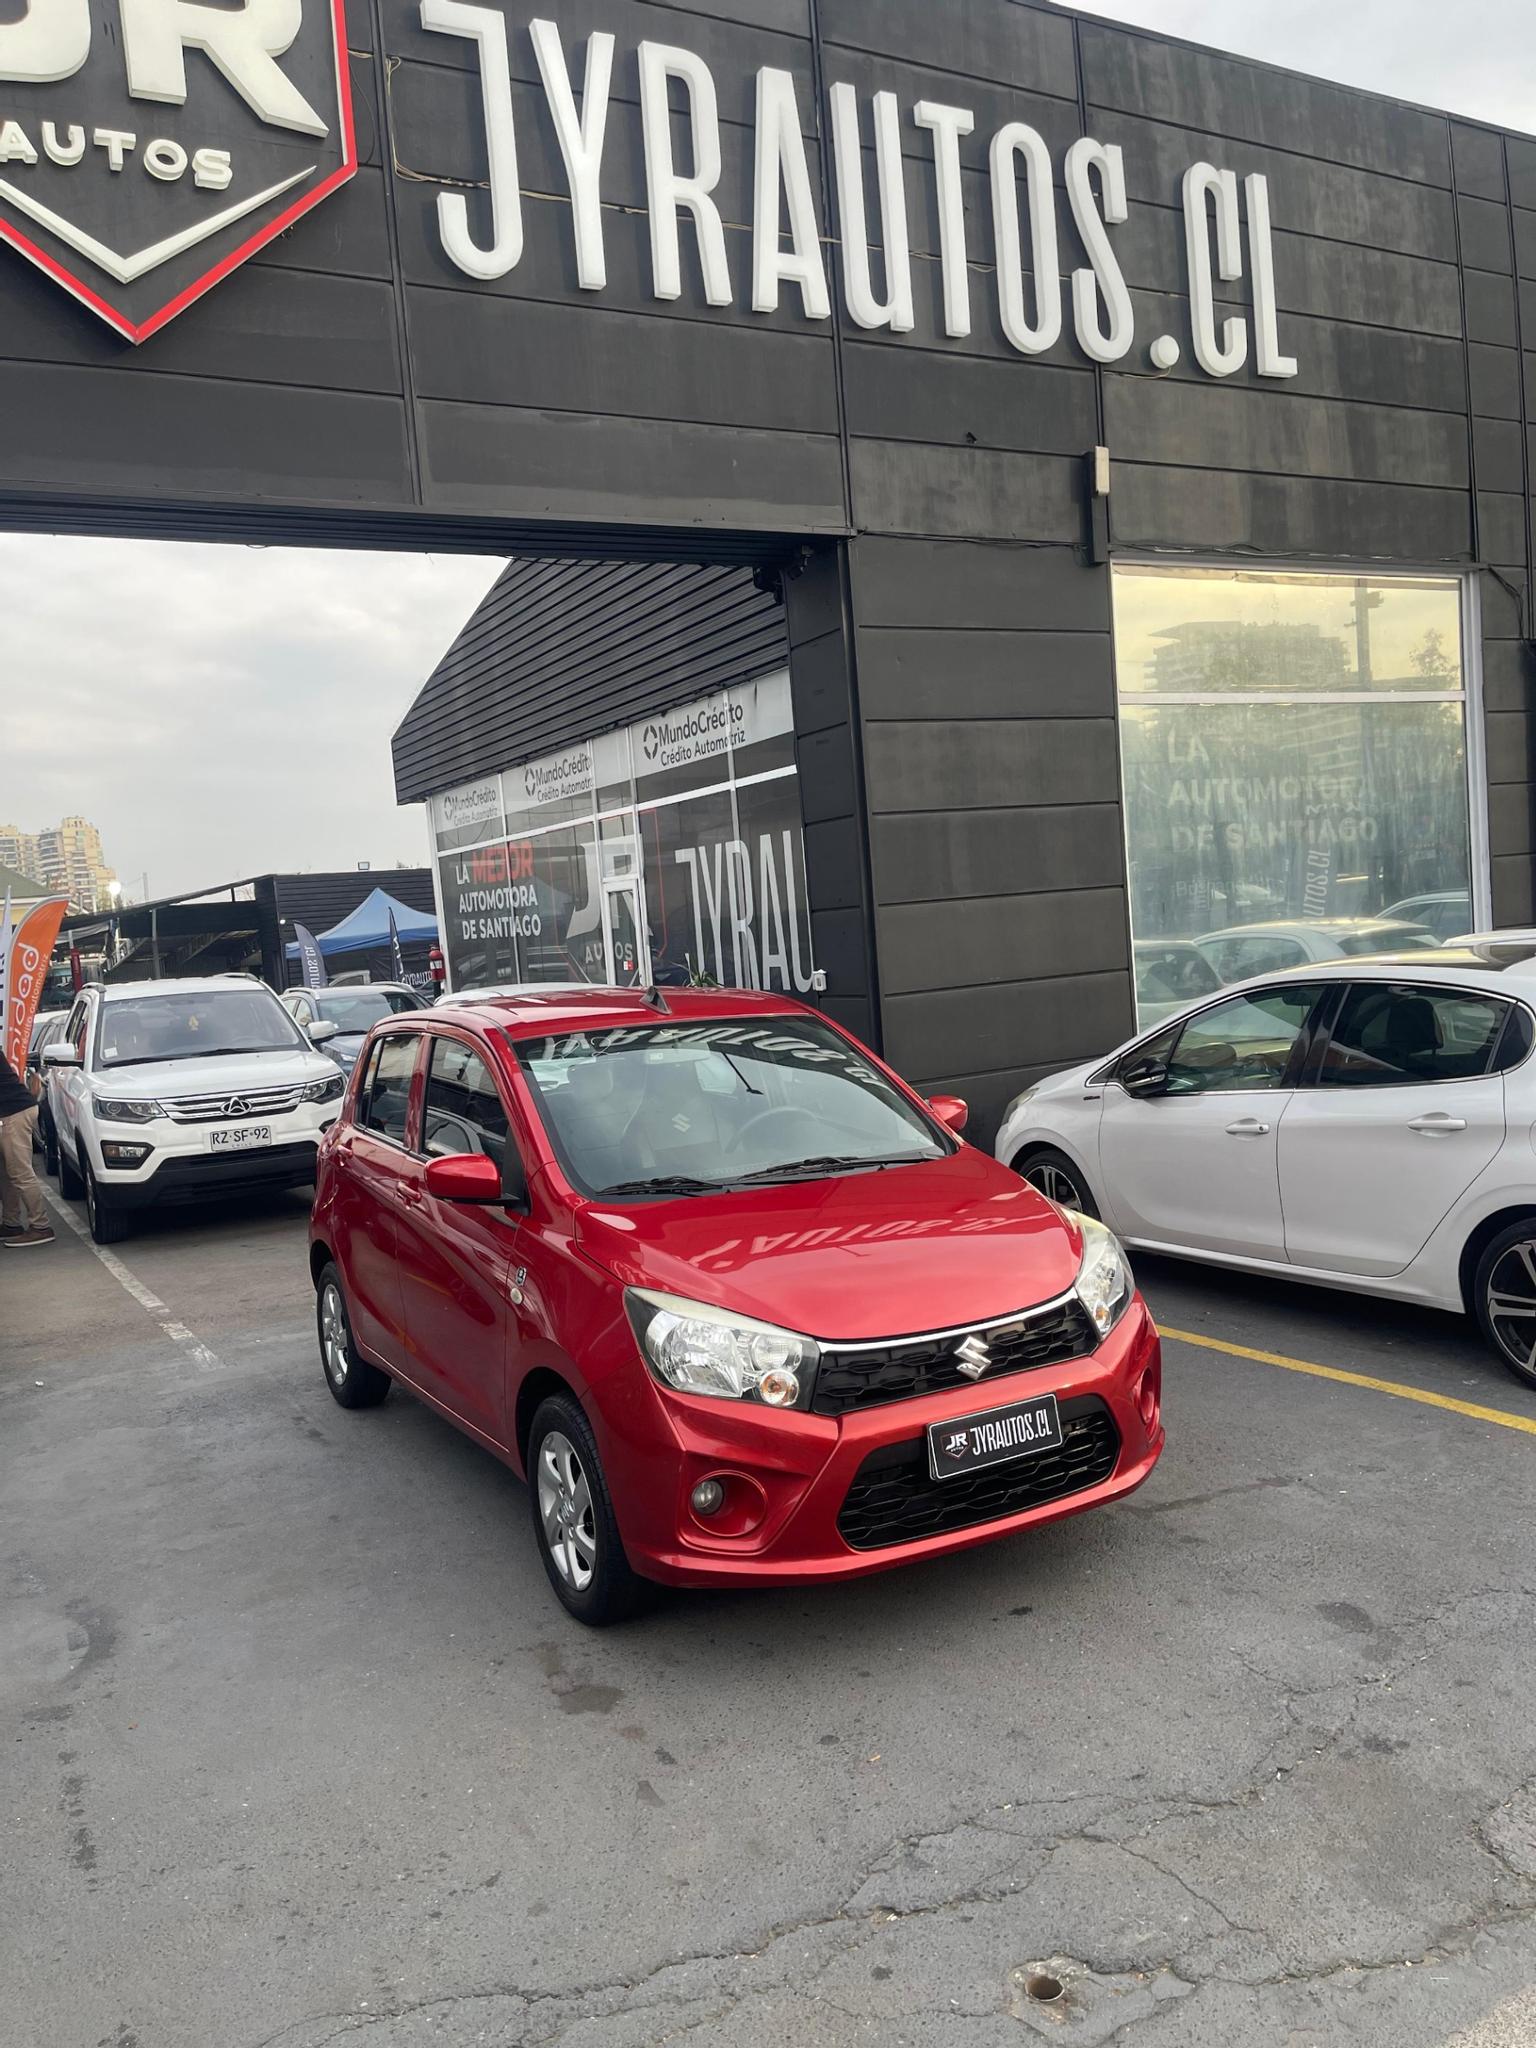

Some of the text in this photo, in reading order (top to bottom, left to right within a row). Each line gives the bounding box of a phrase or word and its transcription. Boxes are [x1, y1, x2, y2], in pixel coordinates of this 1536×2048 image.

[0, 115, 232, 191] AUTOS
[420, 0, 1298, 380] JYRAUTOS.CL
[658, 703, 744, 747] MundoCrédito
[661, 746, 692, 767] Crédito
[455, 841, 534, 885] LA MEJOR
[459, 884, 539, 914] AUTOMOTORA
[462, 914, 542, 940] DE SANTIAGO
[585, 942, 633, 964] AUOS
[970, 1408, 1053, 1456] JYRAUTOS.CL
